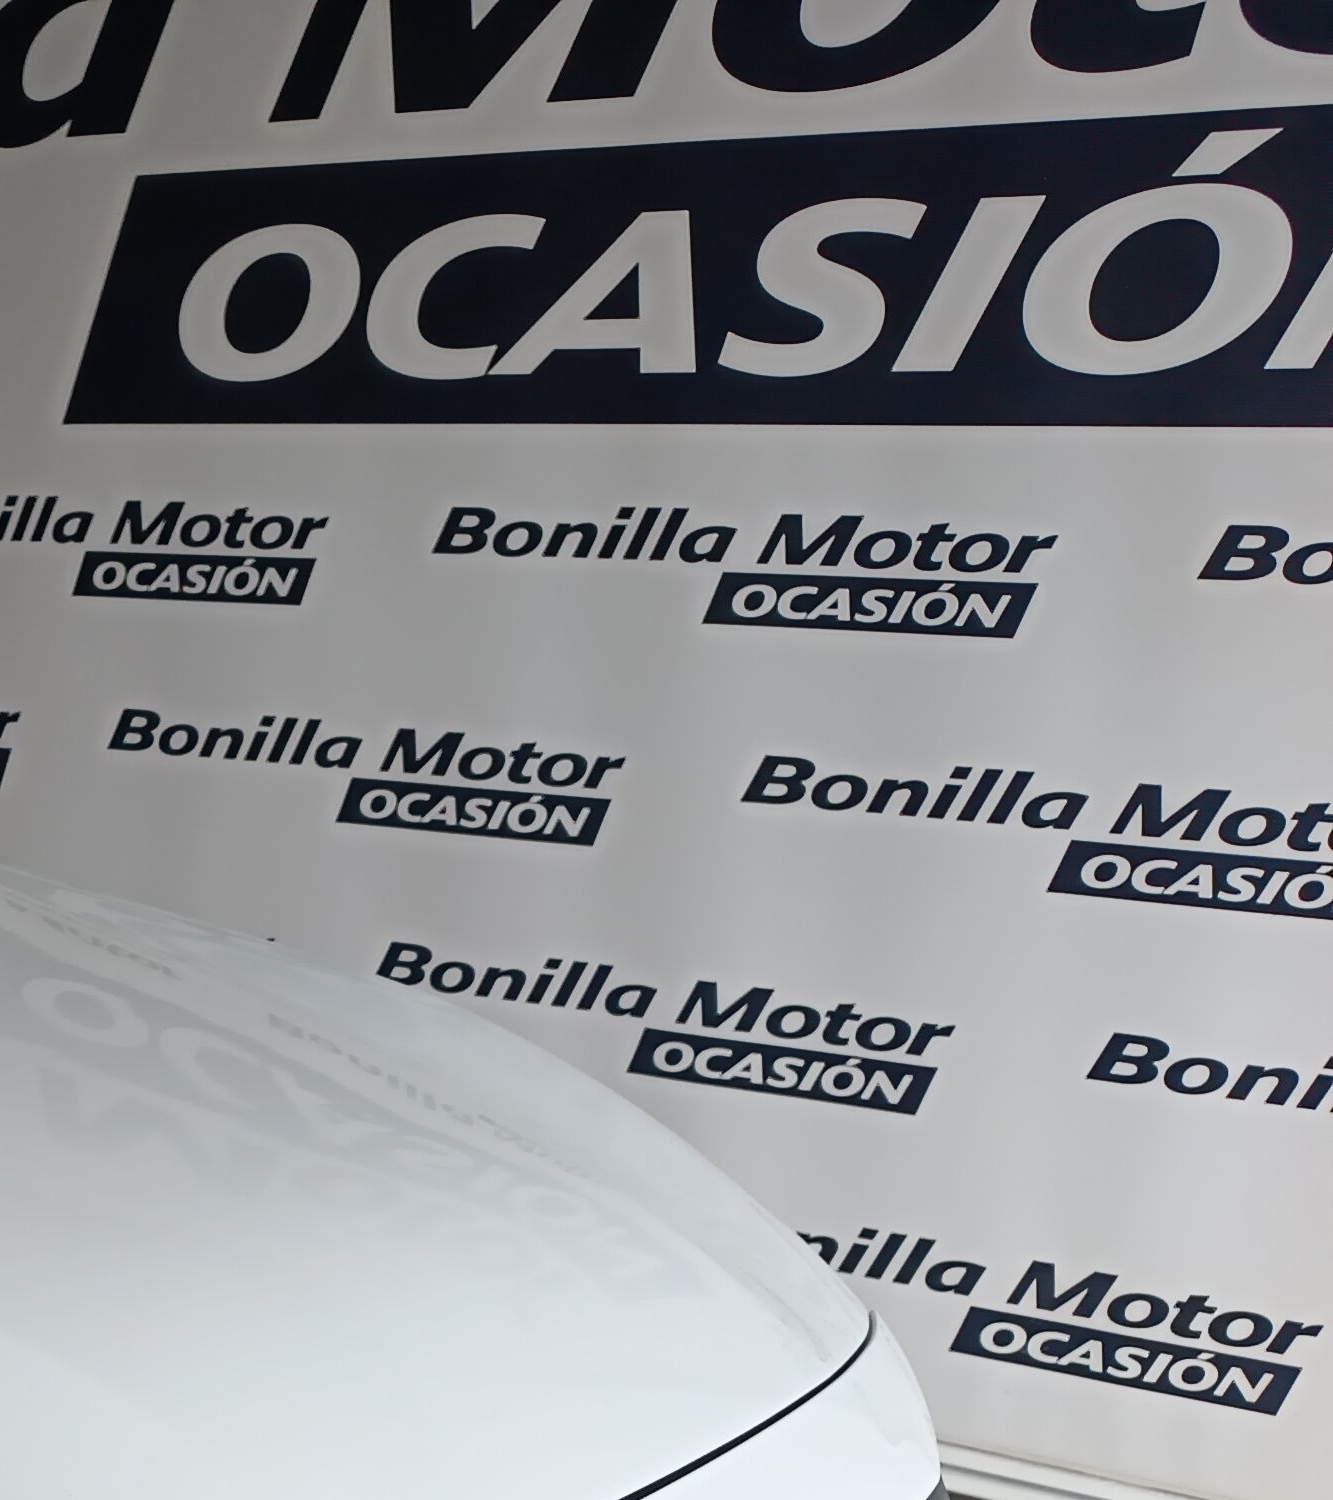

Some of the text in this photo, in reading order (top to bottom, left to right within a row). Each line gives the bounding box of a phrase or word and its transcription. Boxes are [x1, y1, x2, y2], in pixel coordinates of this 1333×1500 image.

[178, 126, 1333, 383] OCASIÓ
[110, 499, 330, 550] Motor
[432, 506, 1059, 574] Bonilla Motor
[92, 558, 299, 598] OCASIÓN
[732, 583, 1012, 629] OCASIÓN
[107, 708, 627, 790] Bonilla Motor
[358, 789, 592, 838] OCASIÓN
[742, 755, 1089, 830] Bonilla
[376, 941, 956, 1057] Bonilla Motor
[652, 1041, 914, 1106] OCASIÓN
[1006, 1260, 1324, 1354] Motor
[979, 1322, 1275, 1403] OCASIÓN
